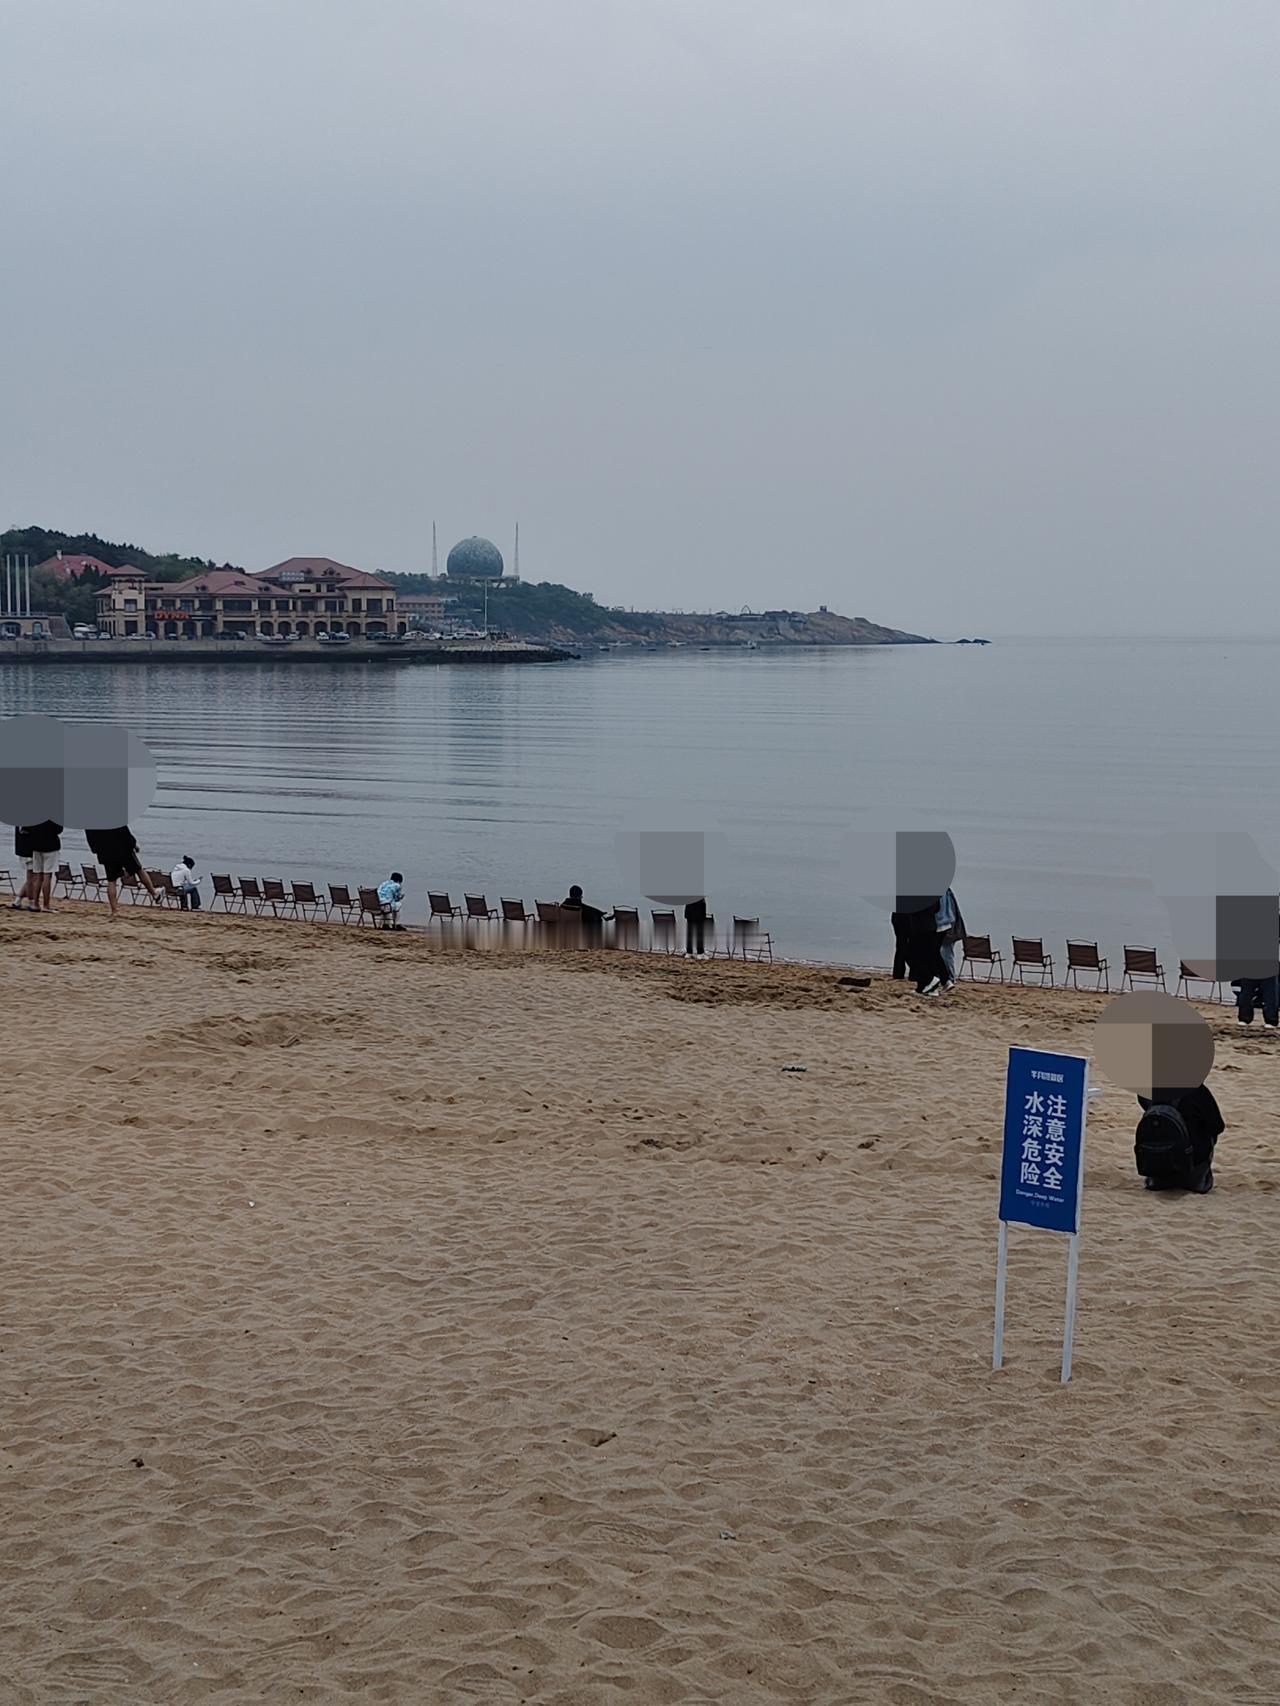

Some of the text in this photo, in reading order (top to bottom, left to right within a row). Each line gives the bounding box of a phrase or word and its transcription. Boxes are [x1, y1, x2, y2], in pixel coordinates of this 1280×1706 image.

[1020, 1091, 1045, 1186] 水深危险
[1043, 1094, 1067, 1190] 注意安全
